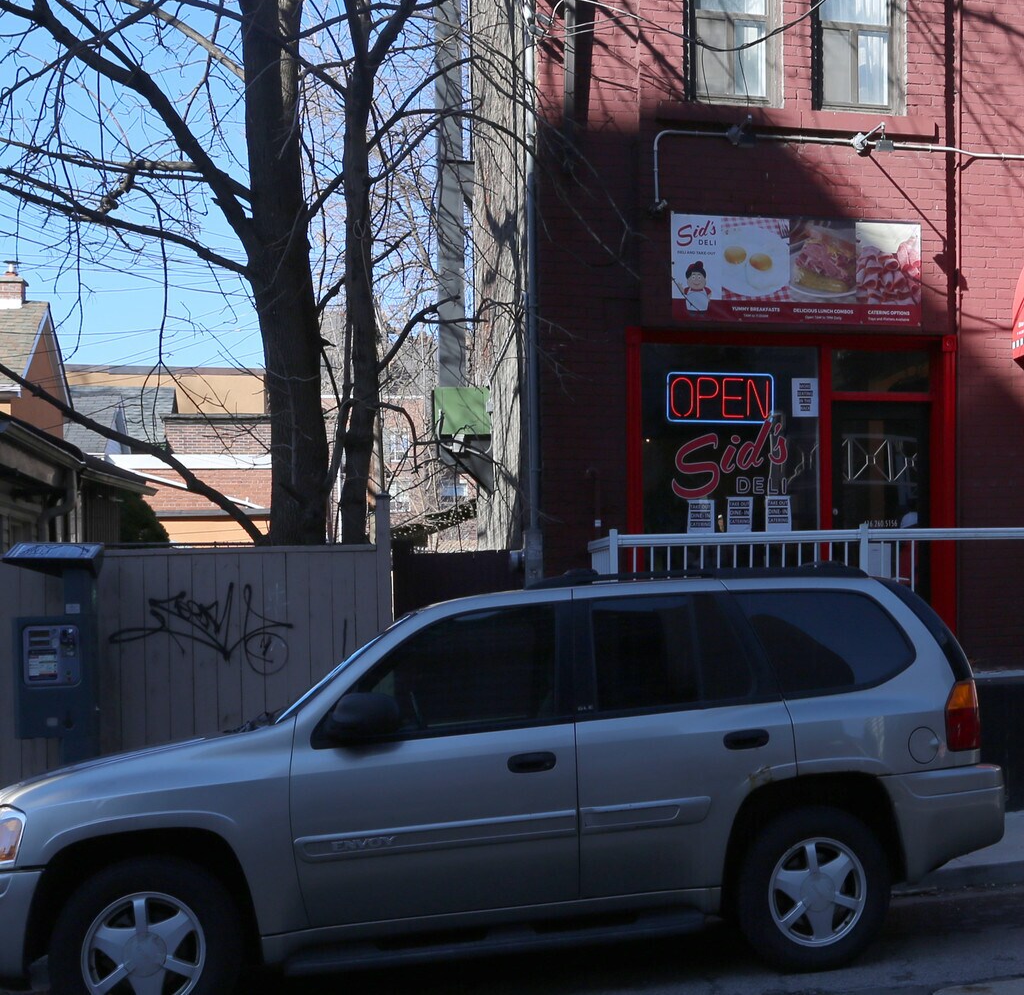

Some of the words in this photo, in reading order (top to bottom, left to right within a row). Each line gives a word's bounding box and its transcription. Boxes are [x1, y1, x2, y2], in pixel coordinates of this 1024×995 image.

[676, 219, 716, 247] Sid's
[670, 377, 769, 419] OPEN
[671, 419, 788, 499] Sid's
[736, 476, 788, 494] DELI
[331, 836, 398, 852] ENVOY
